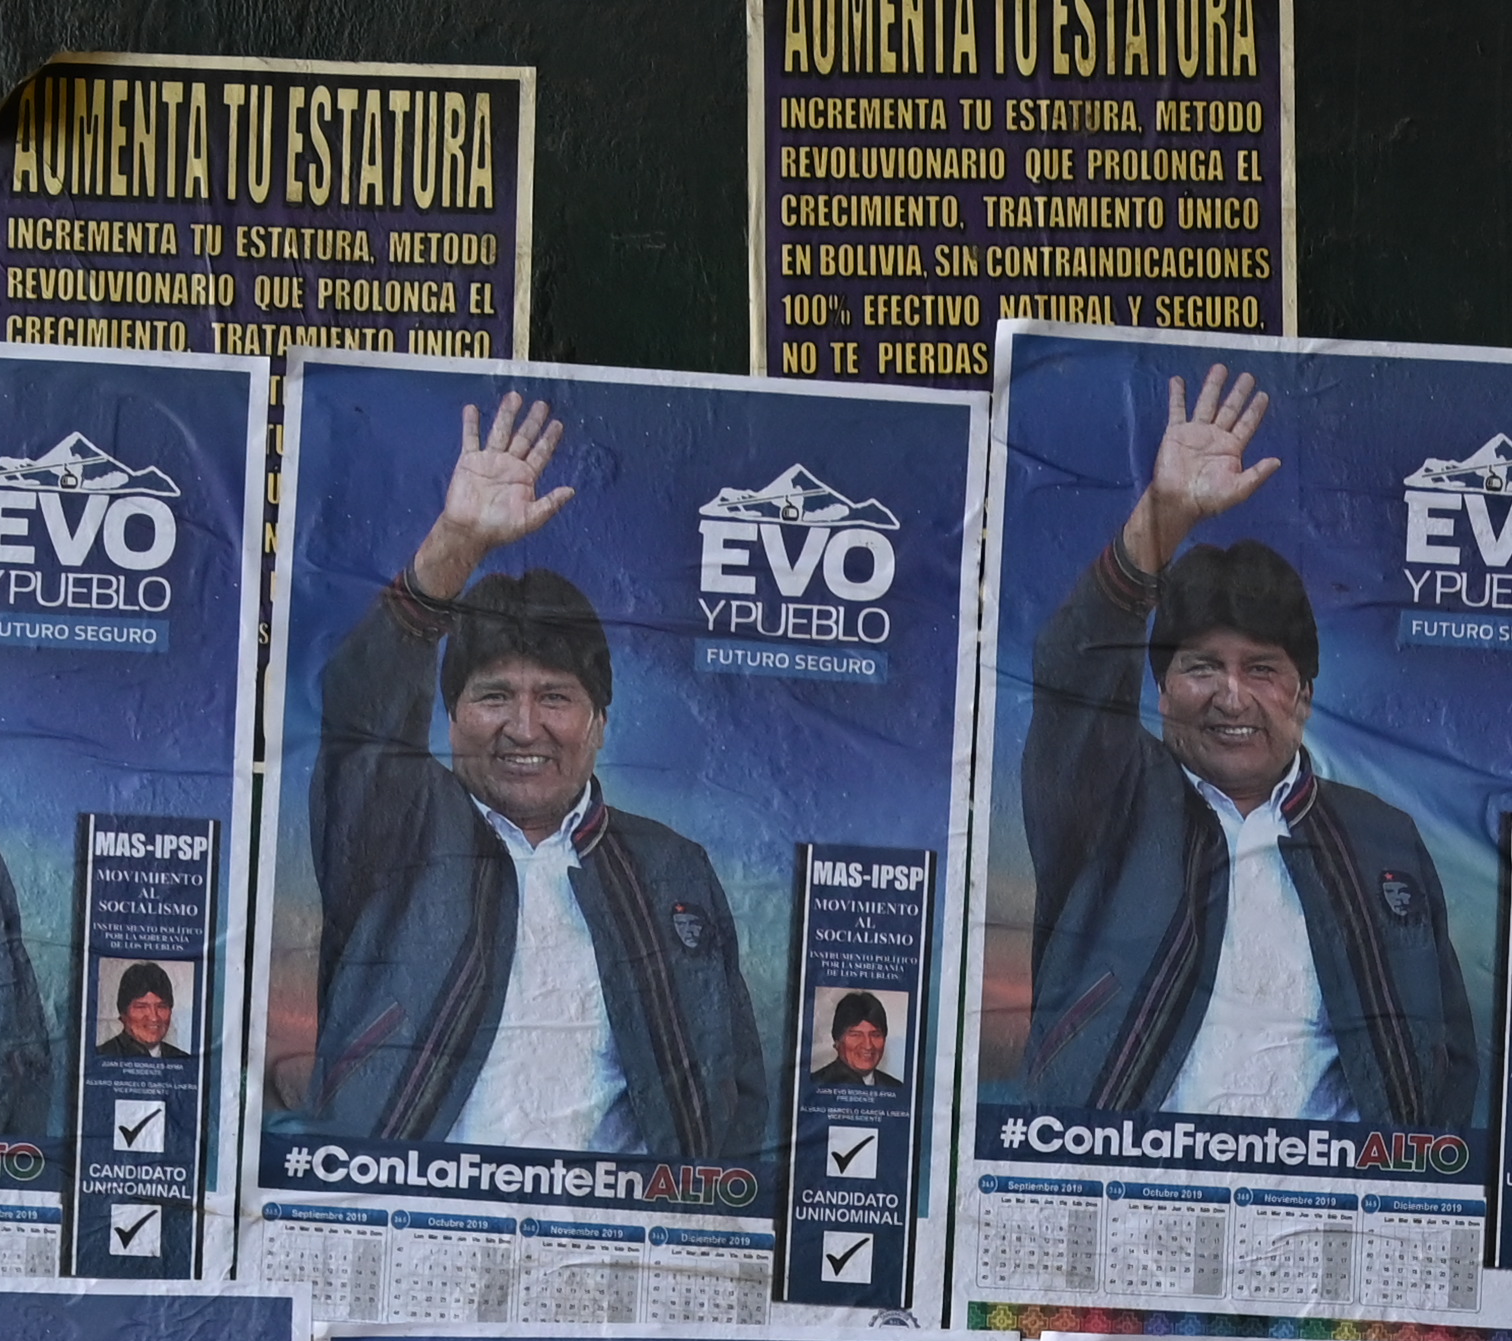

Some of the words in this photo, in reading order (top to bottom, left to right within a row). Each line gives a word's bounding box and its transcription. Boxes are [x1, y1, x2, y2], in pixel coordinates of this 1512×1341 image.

[783, 0, 977, 74] AUMENTA
[994, 0, 1037, 75] TU
[1053, 0, 1258, 77] ESTATURA
[781, 97, 947, 130] INCREMENTA
[960, 98, 991, 130] TU
[1006, 100, 1143, 134] ESTATURA,
[1156, 100, 1263, 133] METODO
[12, 77, 209, 198] AUMENTA
[224, 83, 273, 203] TU
[286, 85, 493, 209] ESTATURA
[781, 146, 1006, 180] REVOLUVIONARIO
[1025, 149, 1074, 184] QUE
[1088, 149, 1224, 182] PROLONGA
[1237, 149, 1263, 181] EL
[781, 194, 965, 230] CRECIMIENTO,
[984, 196, 1164, 230] TRATAMIENTO
[1177, 188, 1259, 230] ÚNICO
[7, 216, 177, 255] INCREMENTA
[191, 223, 222, 257] TU
[236, 226, 374, 264] ESTATURA,
[388, 232, 497, 265] METODO
[781, 244, 813, 276] EN
[819, 244, 928, 278] BOLIVIA,
[935, 246, 979, 277] SIN
[986, 247, 1270, 280] CONTRAINDICACIONES
[781, 293, 851, 327] 100%
[863, 294, 981, 326] EFECTIVO
[1127, 295, 1143, 327] Y
[1156, 295, 1264, 331] SEGURO,
[699, 520, 895, 602] EVO
[1000, 1114, 1469, 1173] #ConLaFrenteEnALTO
[285, 1144, 758, 1207] #ConLaFrenteEnALTO
